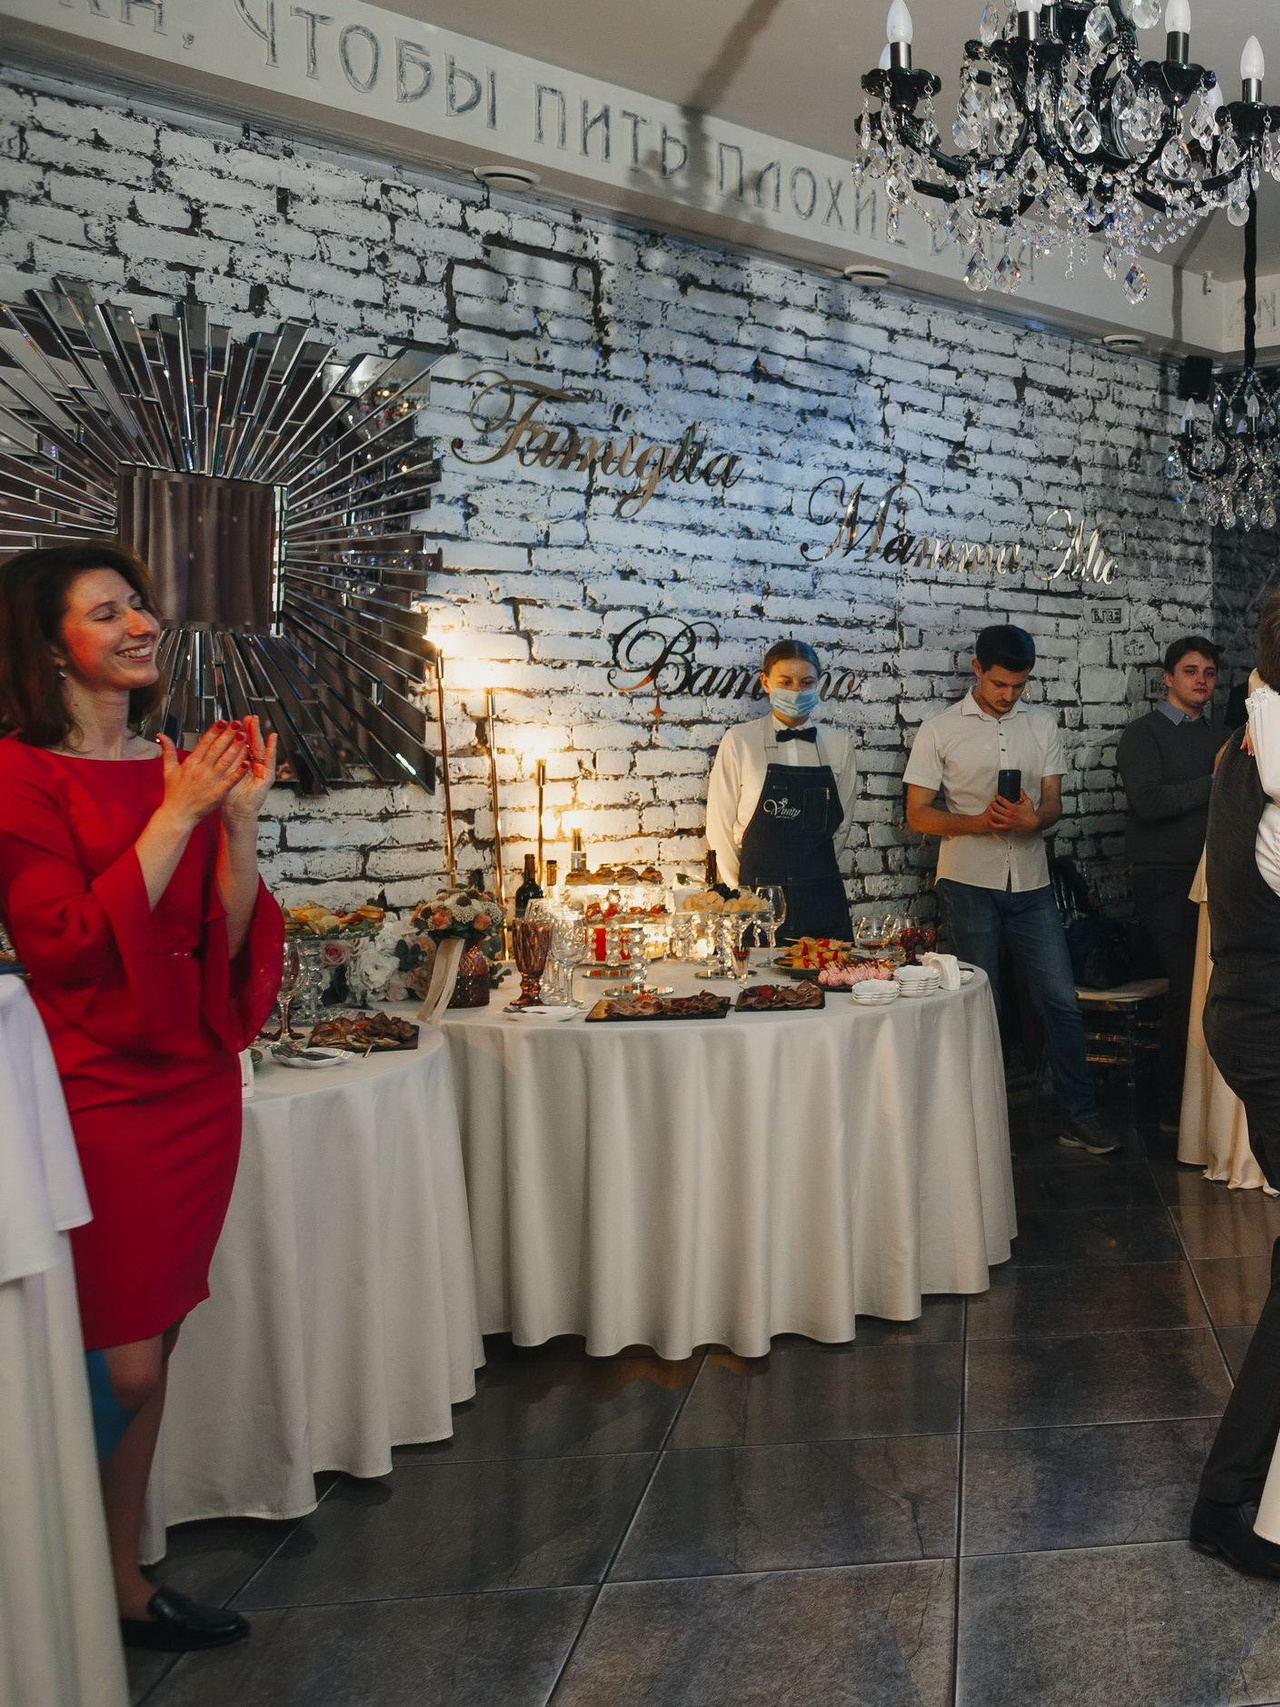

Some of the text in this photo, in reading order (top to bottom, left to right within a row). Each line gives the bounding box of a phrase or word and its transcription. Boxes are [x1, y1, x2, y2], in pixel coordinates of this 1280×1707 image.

[234, 0, 498, 131] ЧТОБЫ
[534, 82, 689, 180] ПИТЬ
[450, 369, 746, 520] Famiglia
[800, 475, 1021, 575] Mamma
[607, 614, 862, 702] Bamno
